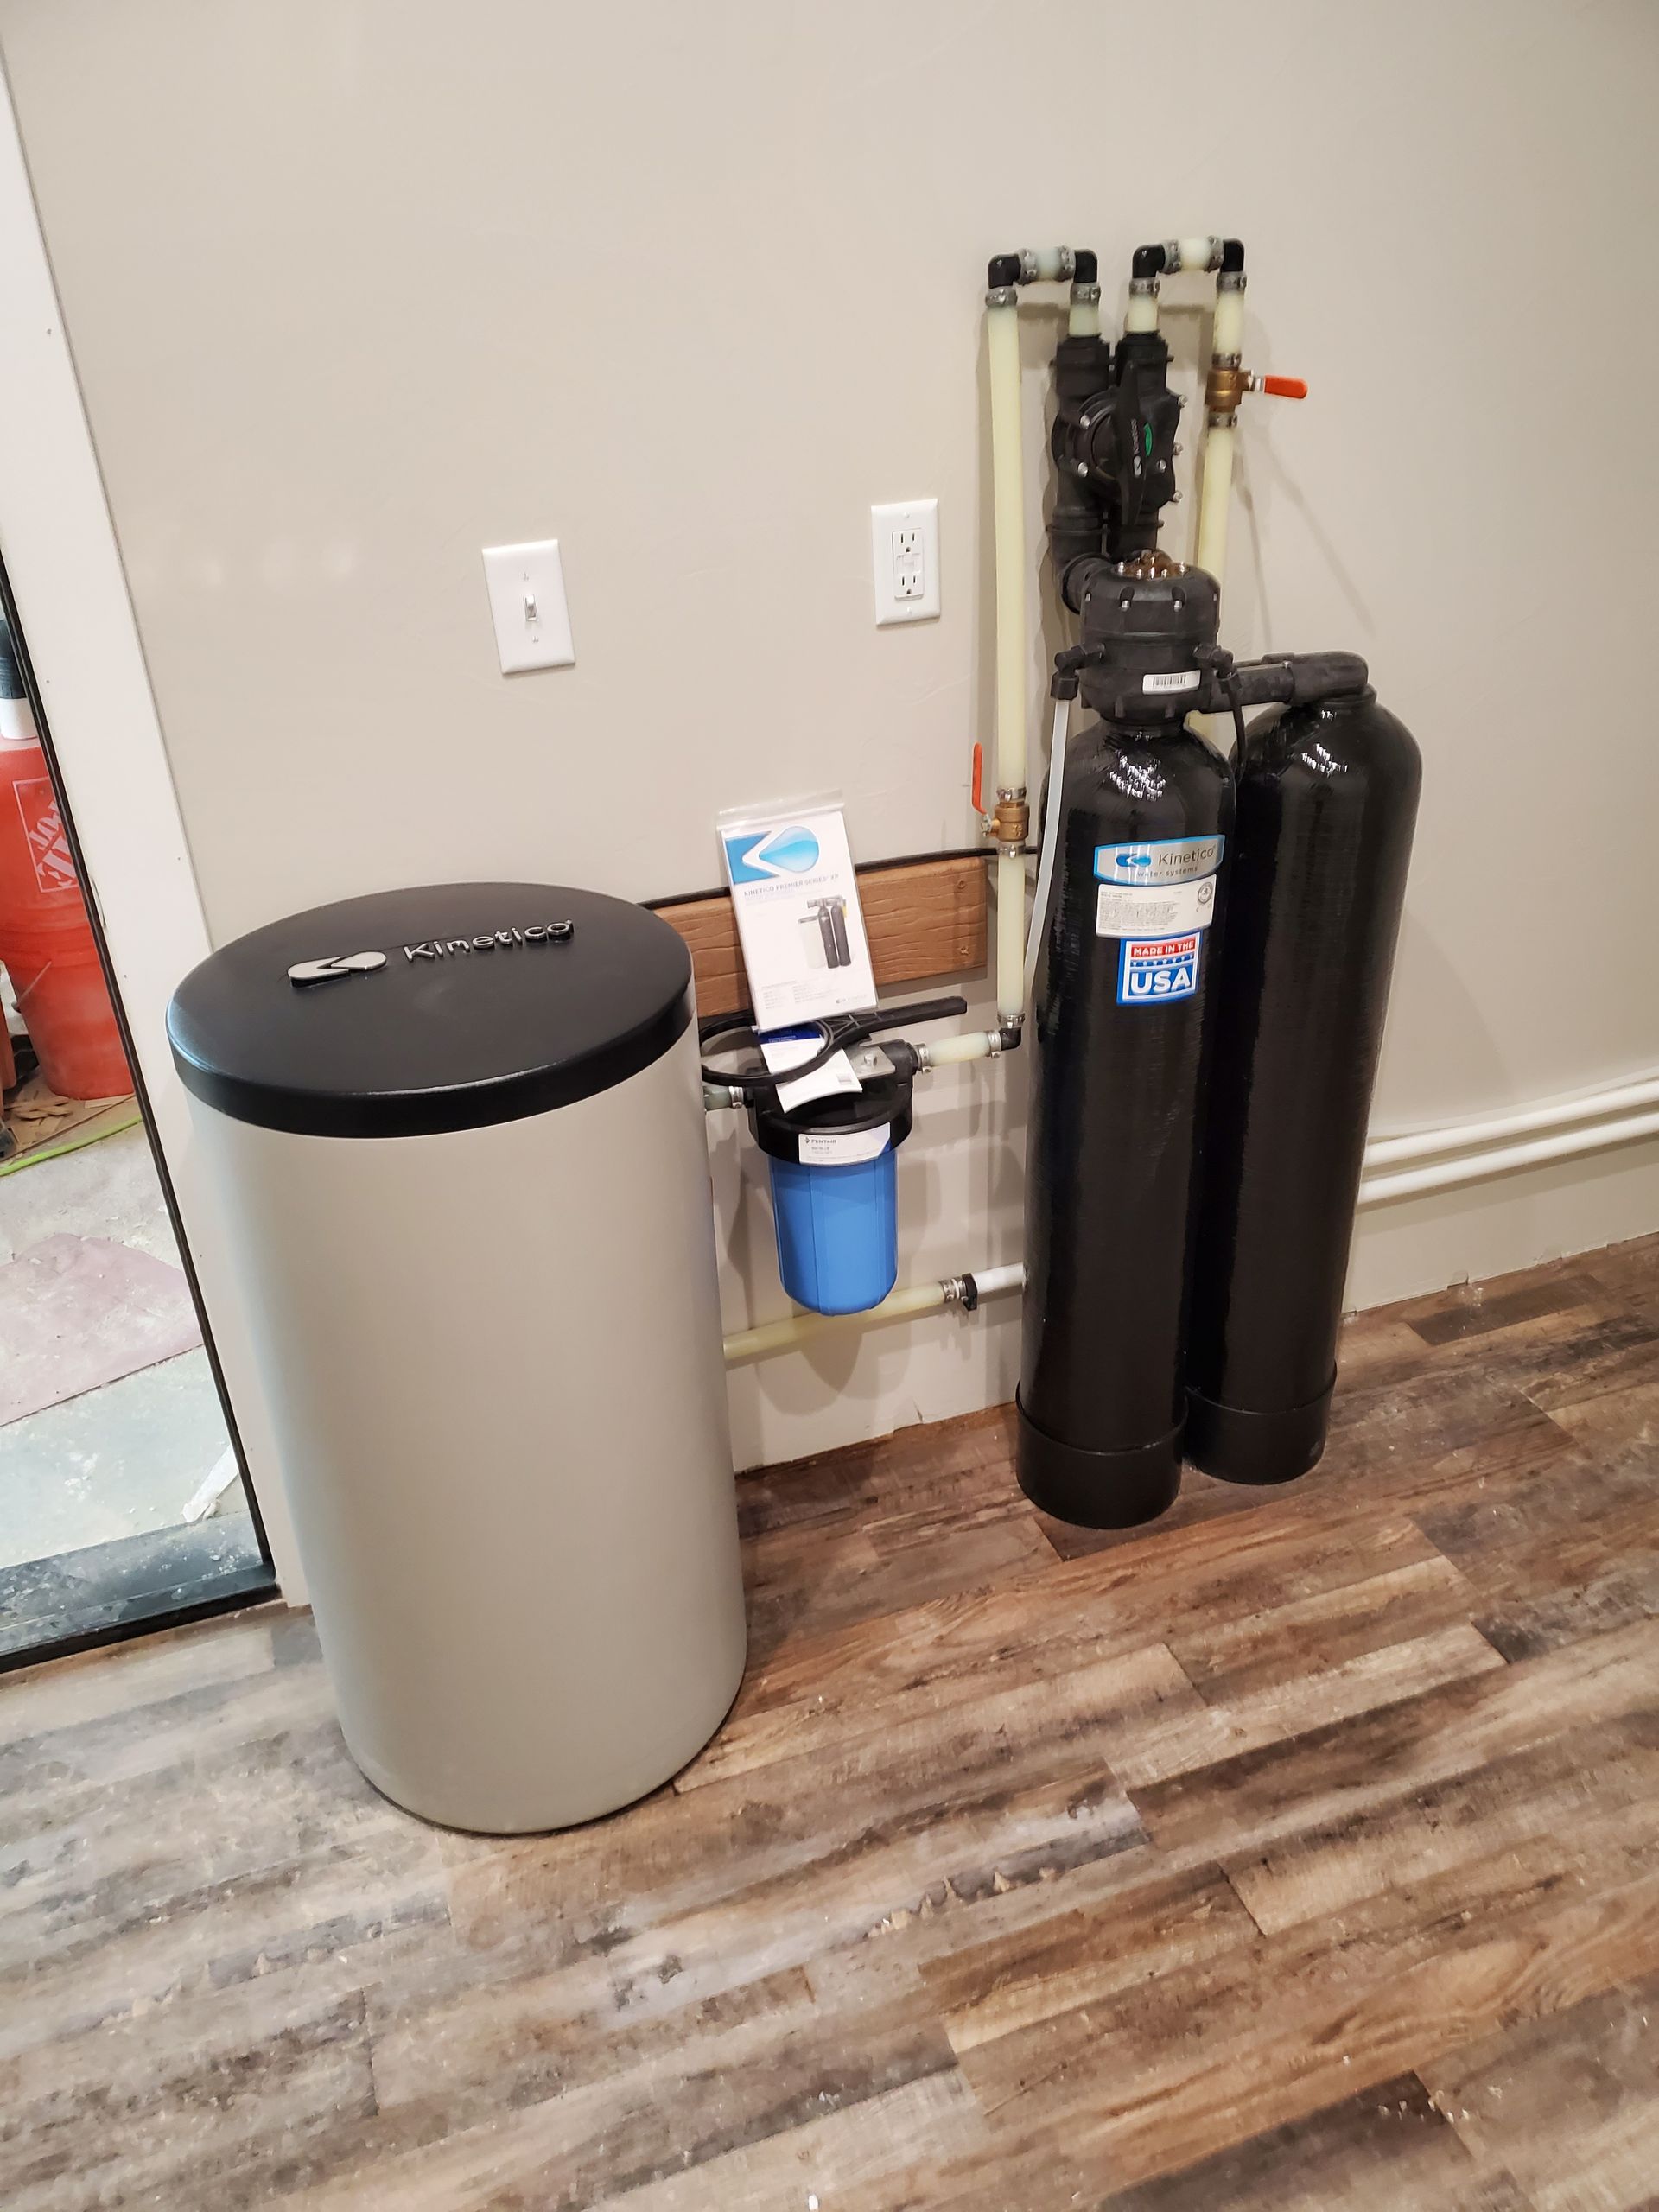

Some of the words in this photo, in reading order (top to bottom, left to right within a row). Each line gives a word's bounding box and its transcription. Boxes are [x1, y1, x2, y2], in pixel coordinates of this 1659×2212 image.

[1159, 848, 1214, 867] Kinetico
[1166, 866, 1198, 877] systems
[744, 887, 774, 897] KINETICO
[776, 880, 804, 891] PREMIER
[404, 919, 574, 963] Kinetico
[1133, 945, 1162, 956] MADE
[1165, 944, 1175, 954] IN
[1177, 941, 1194, 952] THE
[1131, 967, 1191, 995] USA
